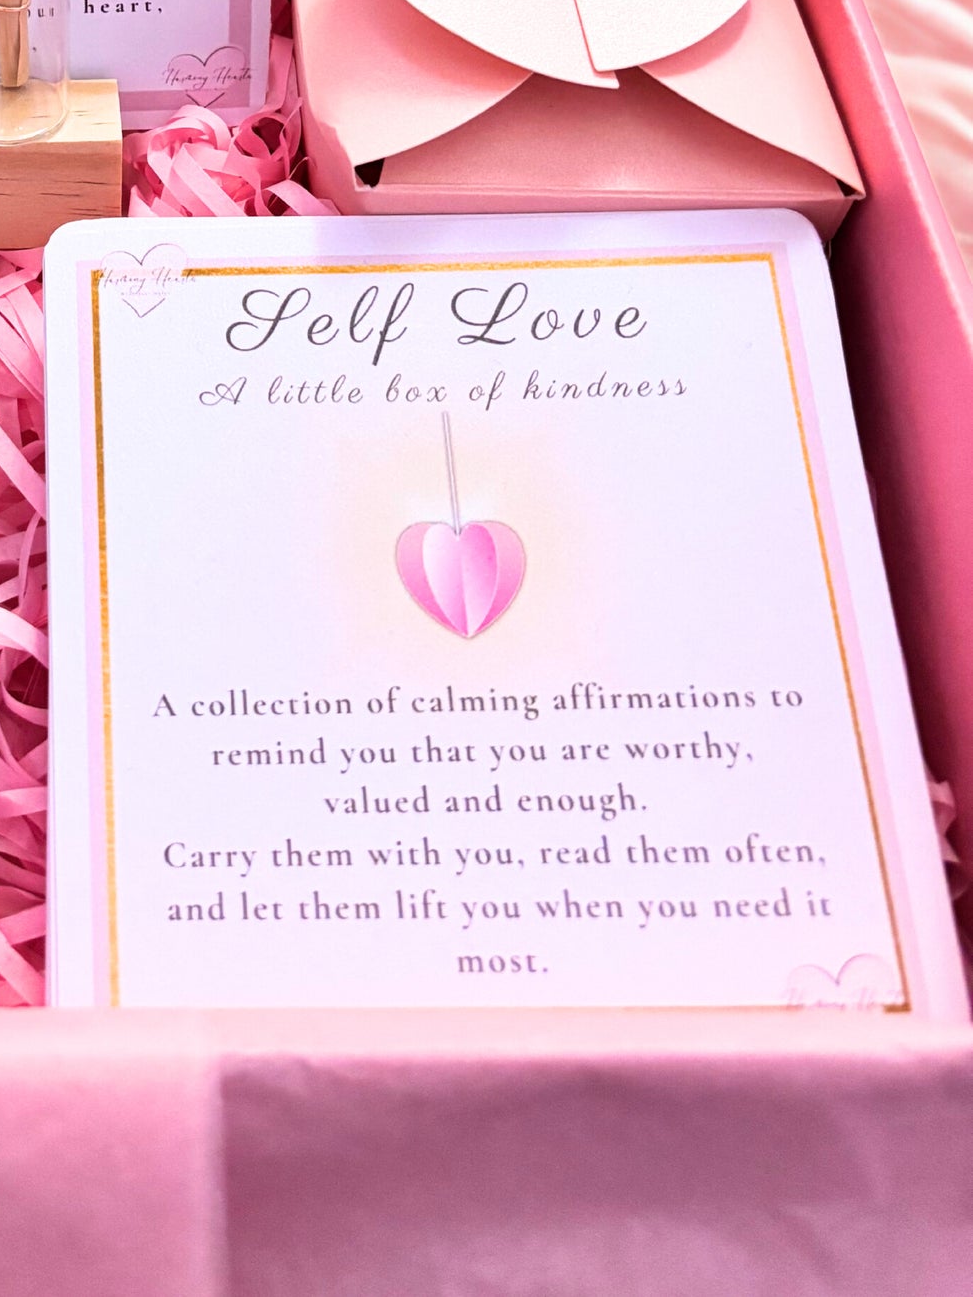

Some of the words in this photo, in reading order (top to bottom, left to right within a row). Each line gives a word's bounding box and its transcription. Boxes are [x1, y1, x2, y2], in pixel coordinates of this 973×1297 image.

[225, 282, 415, 367] Self
[450, 281, 648, 346] Love
[198, 376, 248, 407] A
[267, 373, 364, 405] little
[385, 373, 448, 403] box
[468, 370, 506, 412] of
[522, 369, 688, 400] kindness
[152, 693, 177, 718] A
[191, 688, 353, 717] collection
[366, 685, 401, 714] of
[411, 685, 540, 721] calming
[552, 681, 756, 711] affirmations
[770, 689, 803, 708] to
[212, 736, 327, 766] remind
[340, 747, 397, 775] you
[411, 734, 476, 764] that
[489, 744, 547, 773] you
[561, 743, 610, 761] are
[624, 730, 753, 770] worthy,
[323, 784, 431, 815] valued
[444, 783, 503, 813] and
[517, 781, 647, 822] enough.
[163, 842, 257, 878] Carry
[271, 837, 353, 868] them
[367, 836, 441, 866] with
[454, 847, 525, 876] you,
[539, 834, 612, 865] read
[626, 834, 710, 864] them
[724, 832, 826, 865] often,
[167, 890, 226, 922] and
[240, 890, 283, 921] let
[298, 890, 381, 921] them
[395, 888, 447, 920] lift
[461, 901, 521, 930] you
[535, 888, 624, 919] when
[637, 900, 698, 930] you
[713, 886, 792, 919] need
[806, 890, 832, 918] it
[456, 954, 549, 974] most.
